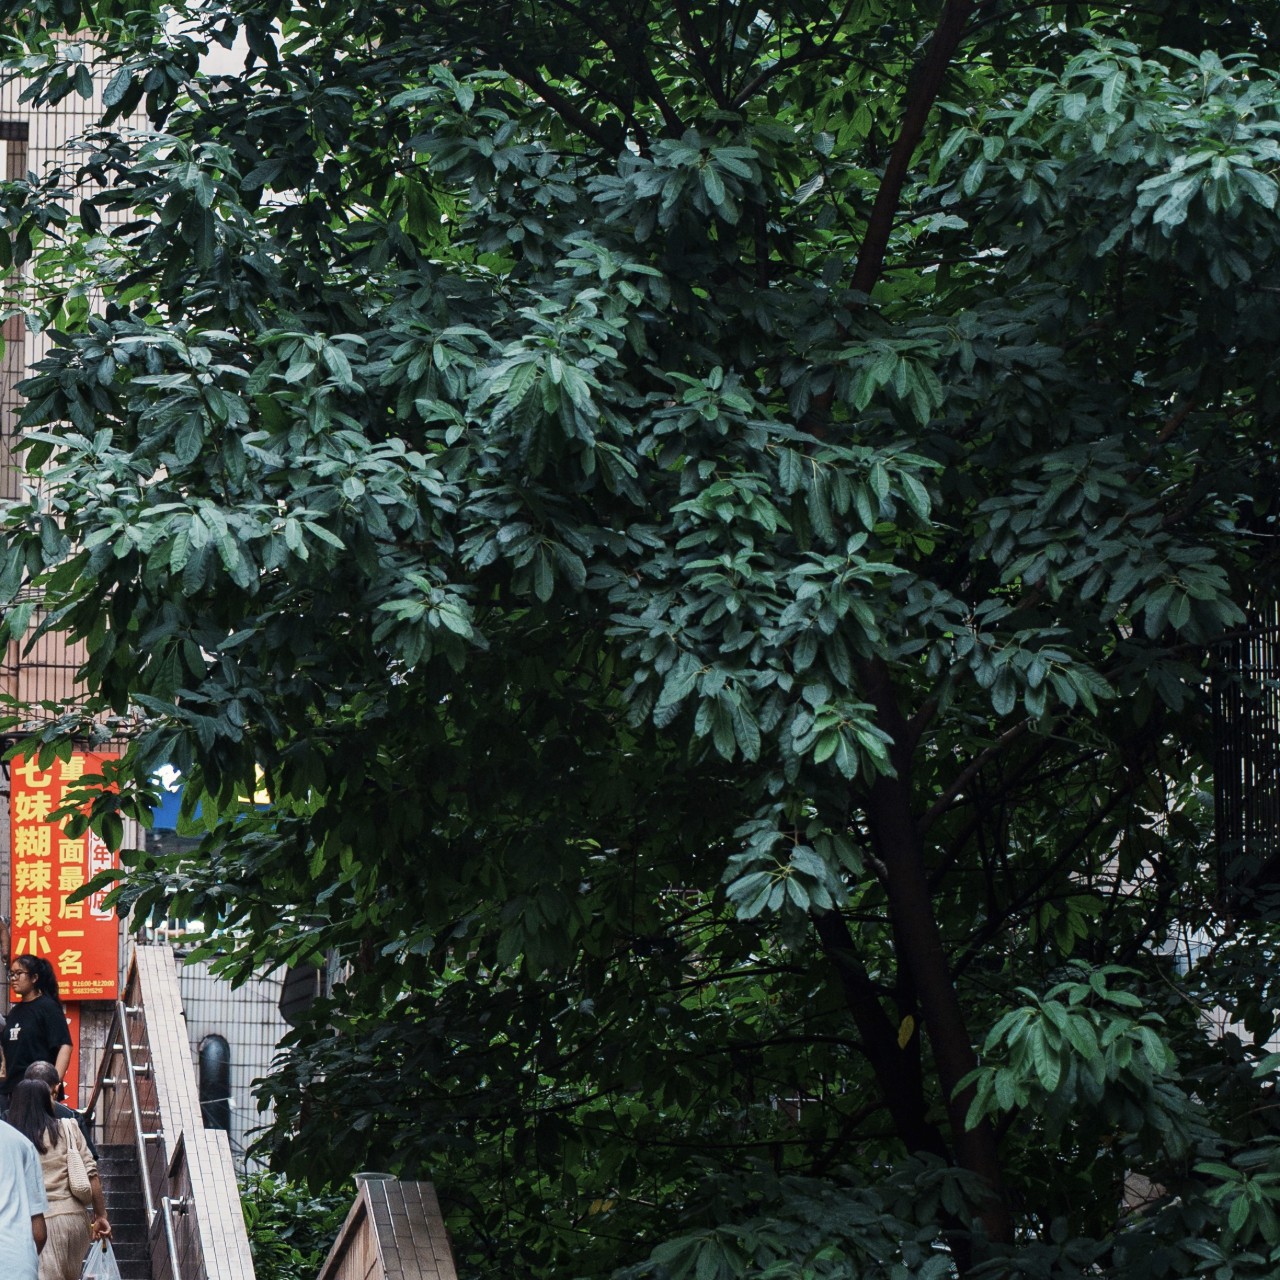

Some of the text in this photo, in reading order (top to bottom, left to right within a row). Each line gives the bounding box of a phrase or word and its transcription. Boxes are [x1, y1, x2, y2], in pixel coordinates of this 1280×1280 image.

[58, 756, 85, 973] 重面最后一名
